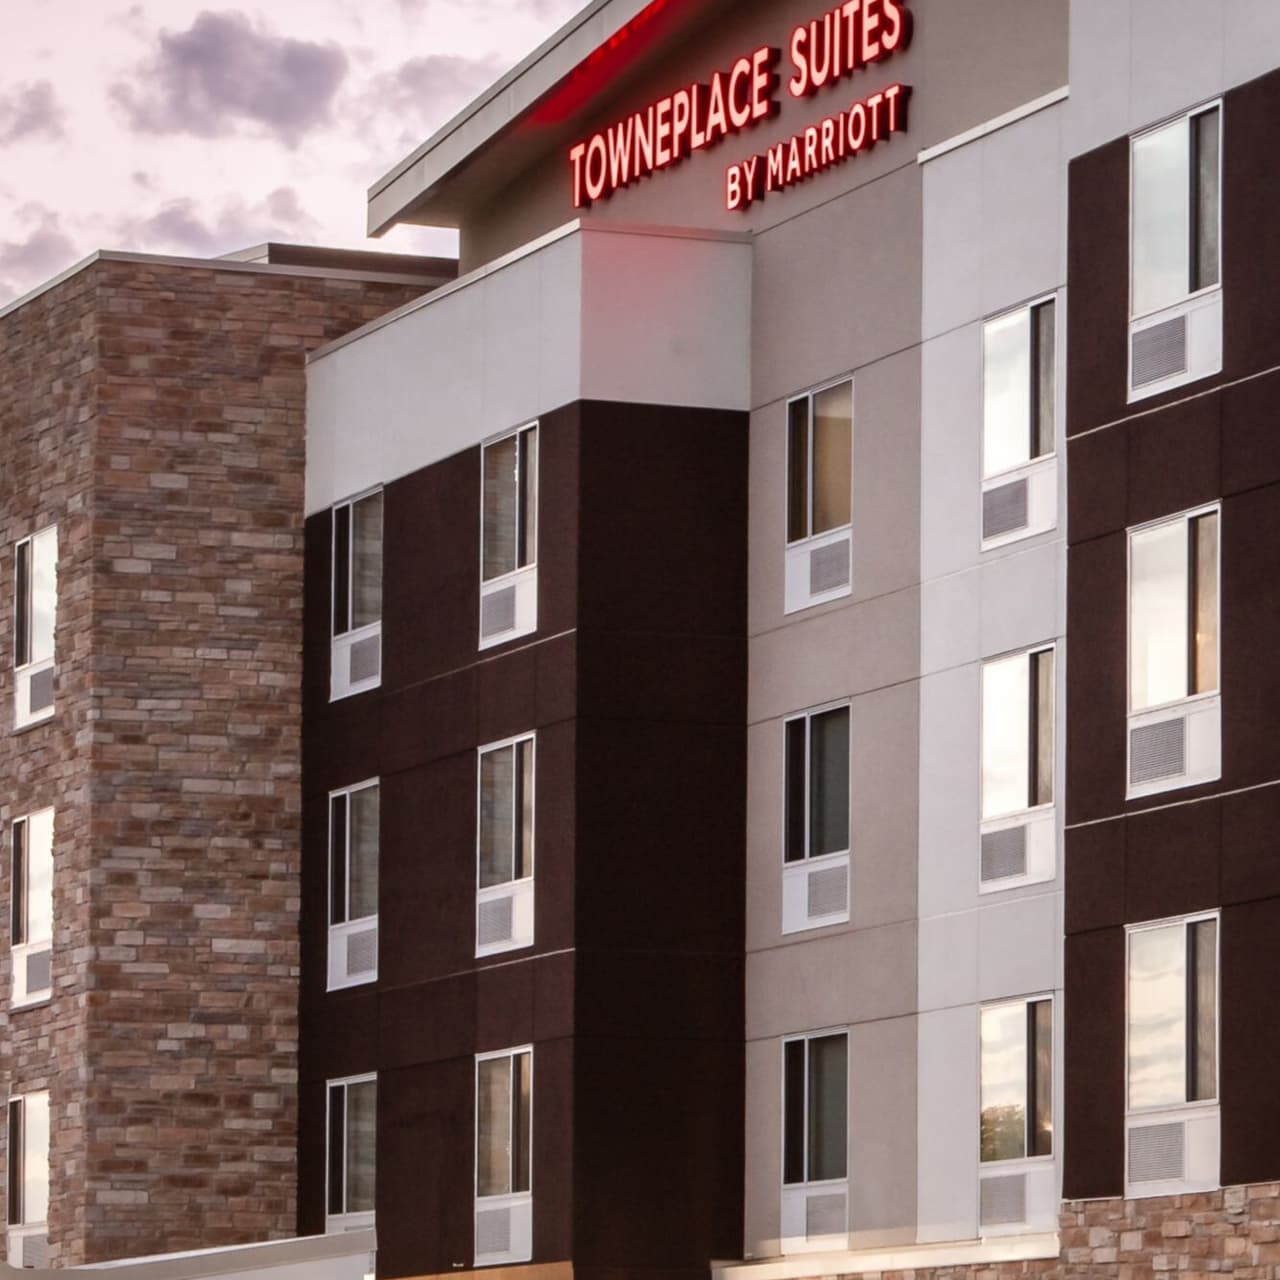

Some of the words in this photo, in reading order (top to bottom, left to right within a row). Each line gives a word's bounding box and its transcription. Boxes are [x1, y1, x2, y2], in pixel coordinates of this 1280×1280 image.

[569, 46, 770, 208] TOWNEPLACE
[726, 154, 759, 211] BY
[766, 83, 901, 193] MARRIOTT
